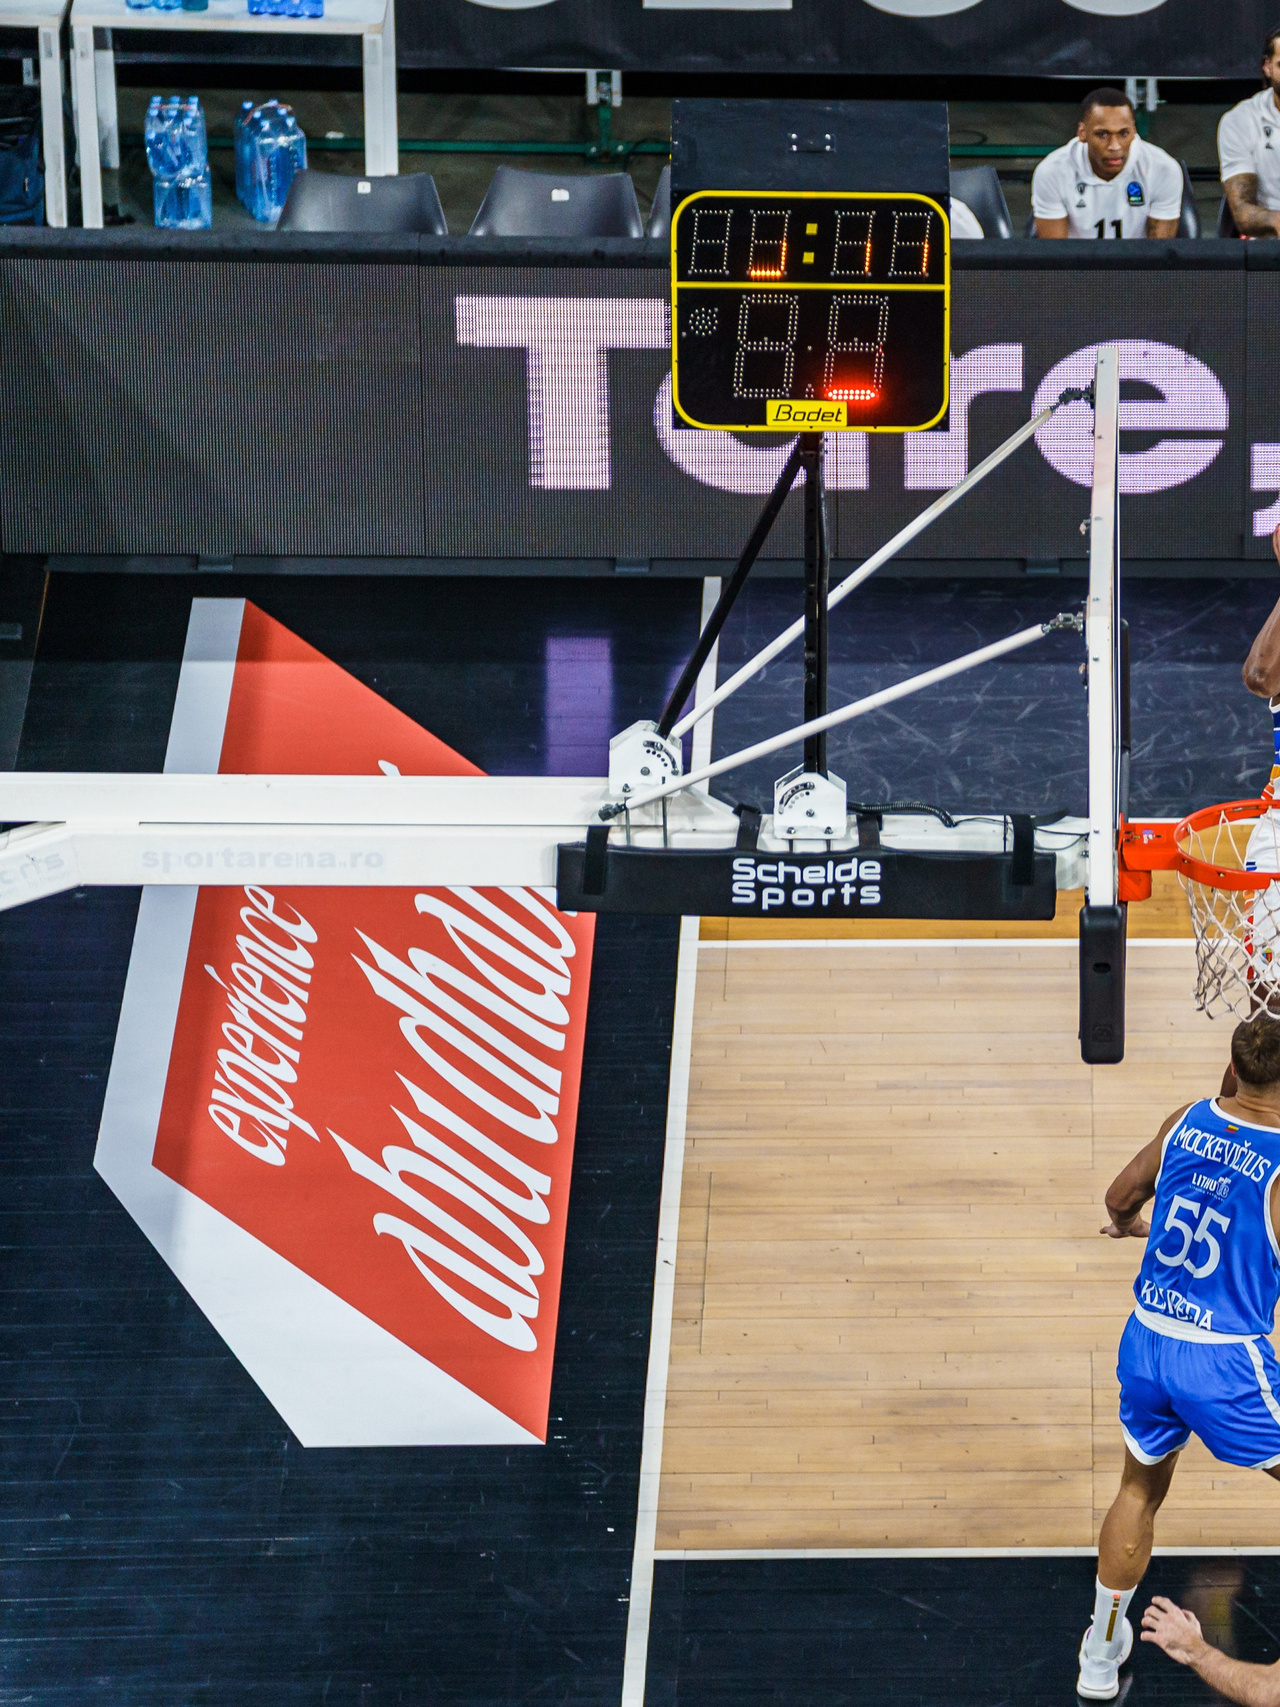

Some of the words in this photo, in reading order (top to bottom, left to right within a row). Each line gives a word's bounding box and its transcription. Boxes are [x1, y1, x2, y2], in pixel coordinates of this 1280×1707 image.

[1094, 218, 1123, 239] 11
[772, 403, 843, 423] Bodet
[732, 857, 881, 885] Schelde
[732, 881, 881, 911] Sports
[1173, 1124, 1272, 1183] MOCKEVIČIUS
[1155, 1194, 1231, 1279] 55
